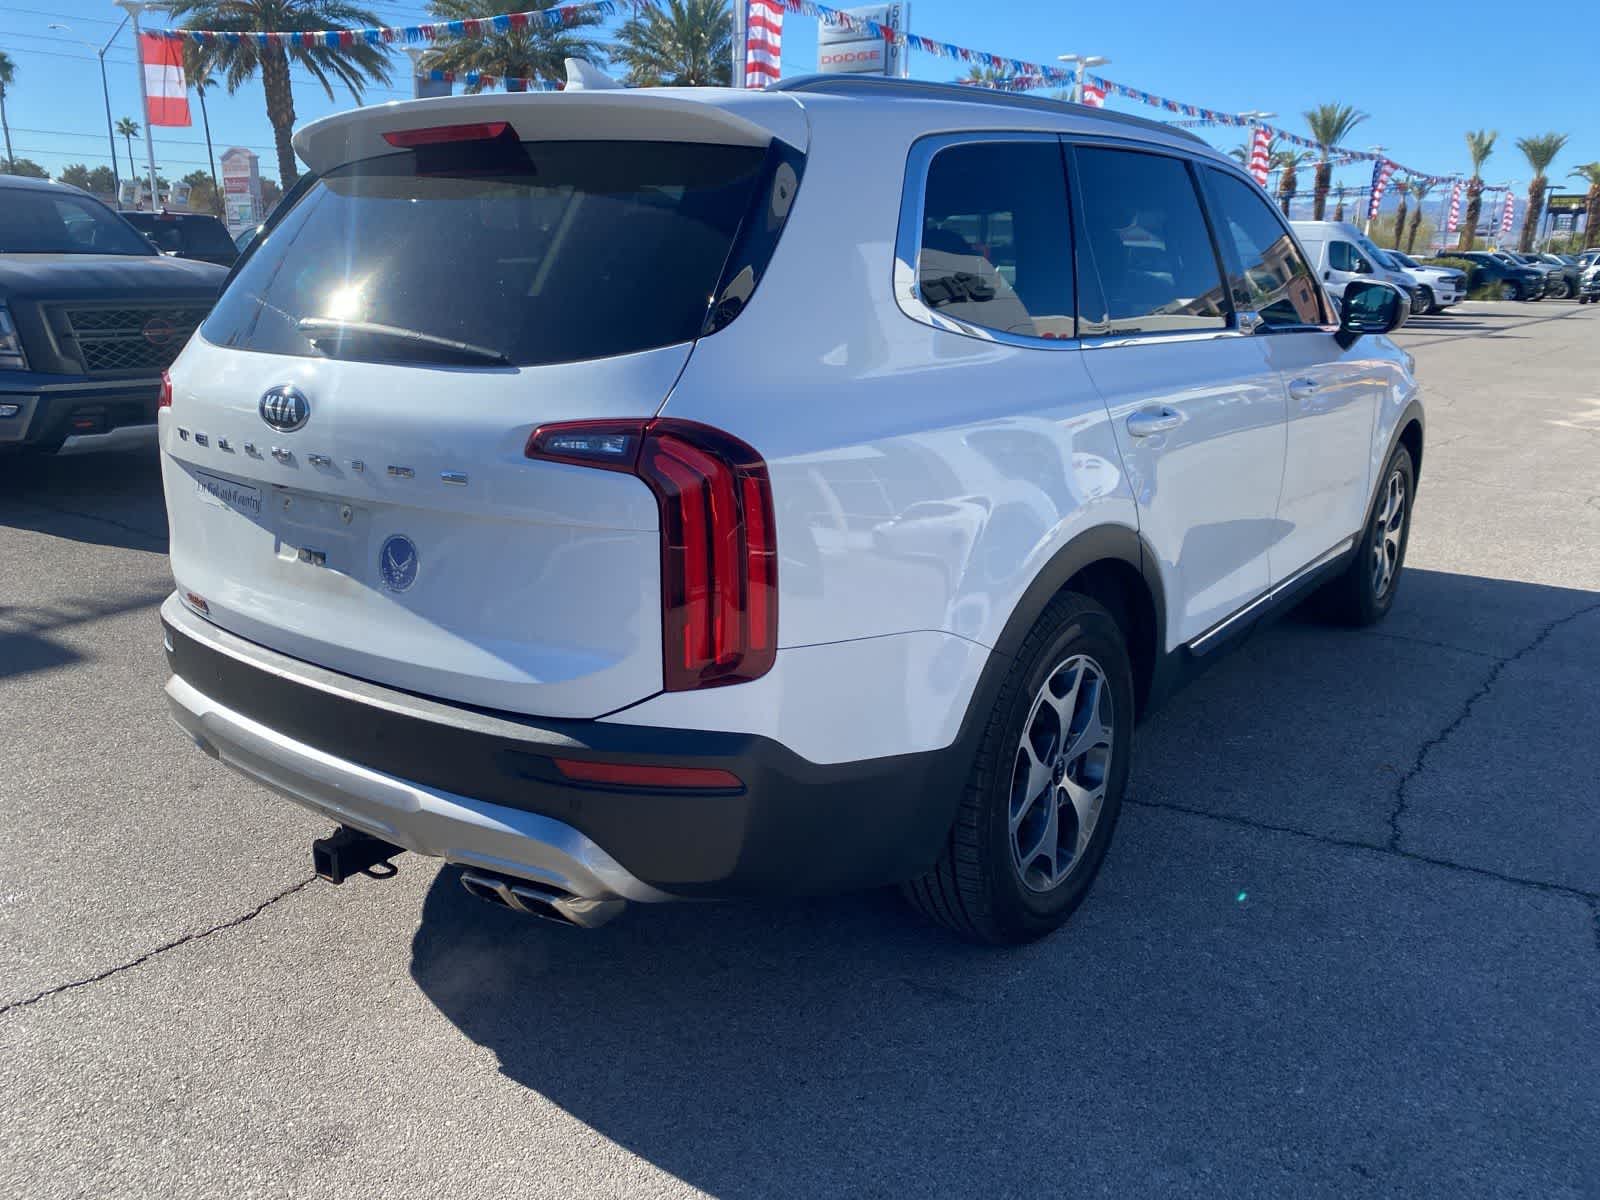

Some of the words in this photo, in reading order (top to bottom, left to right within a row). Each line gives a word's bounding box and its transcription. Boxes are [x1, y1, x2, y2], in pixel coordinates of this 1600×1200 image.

[890, 4, 900, 58] 500
[821, 50, 881, 64] DODGE
[263, 393, 299, 423] KIA
